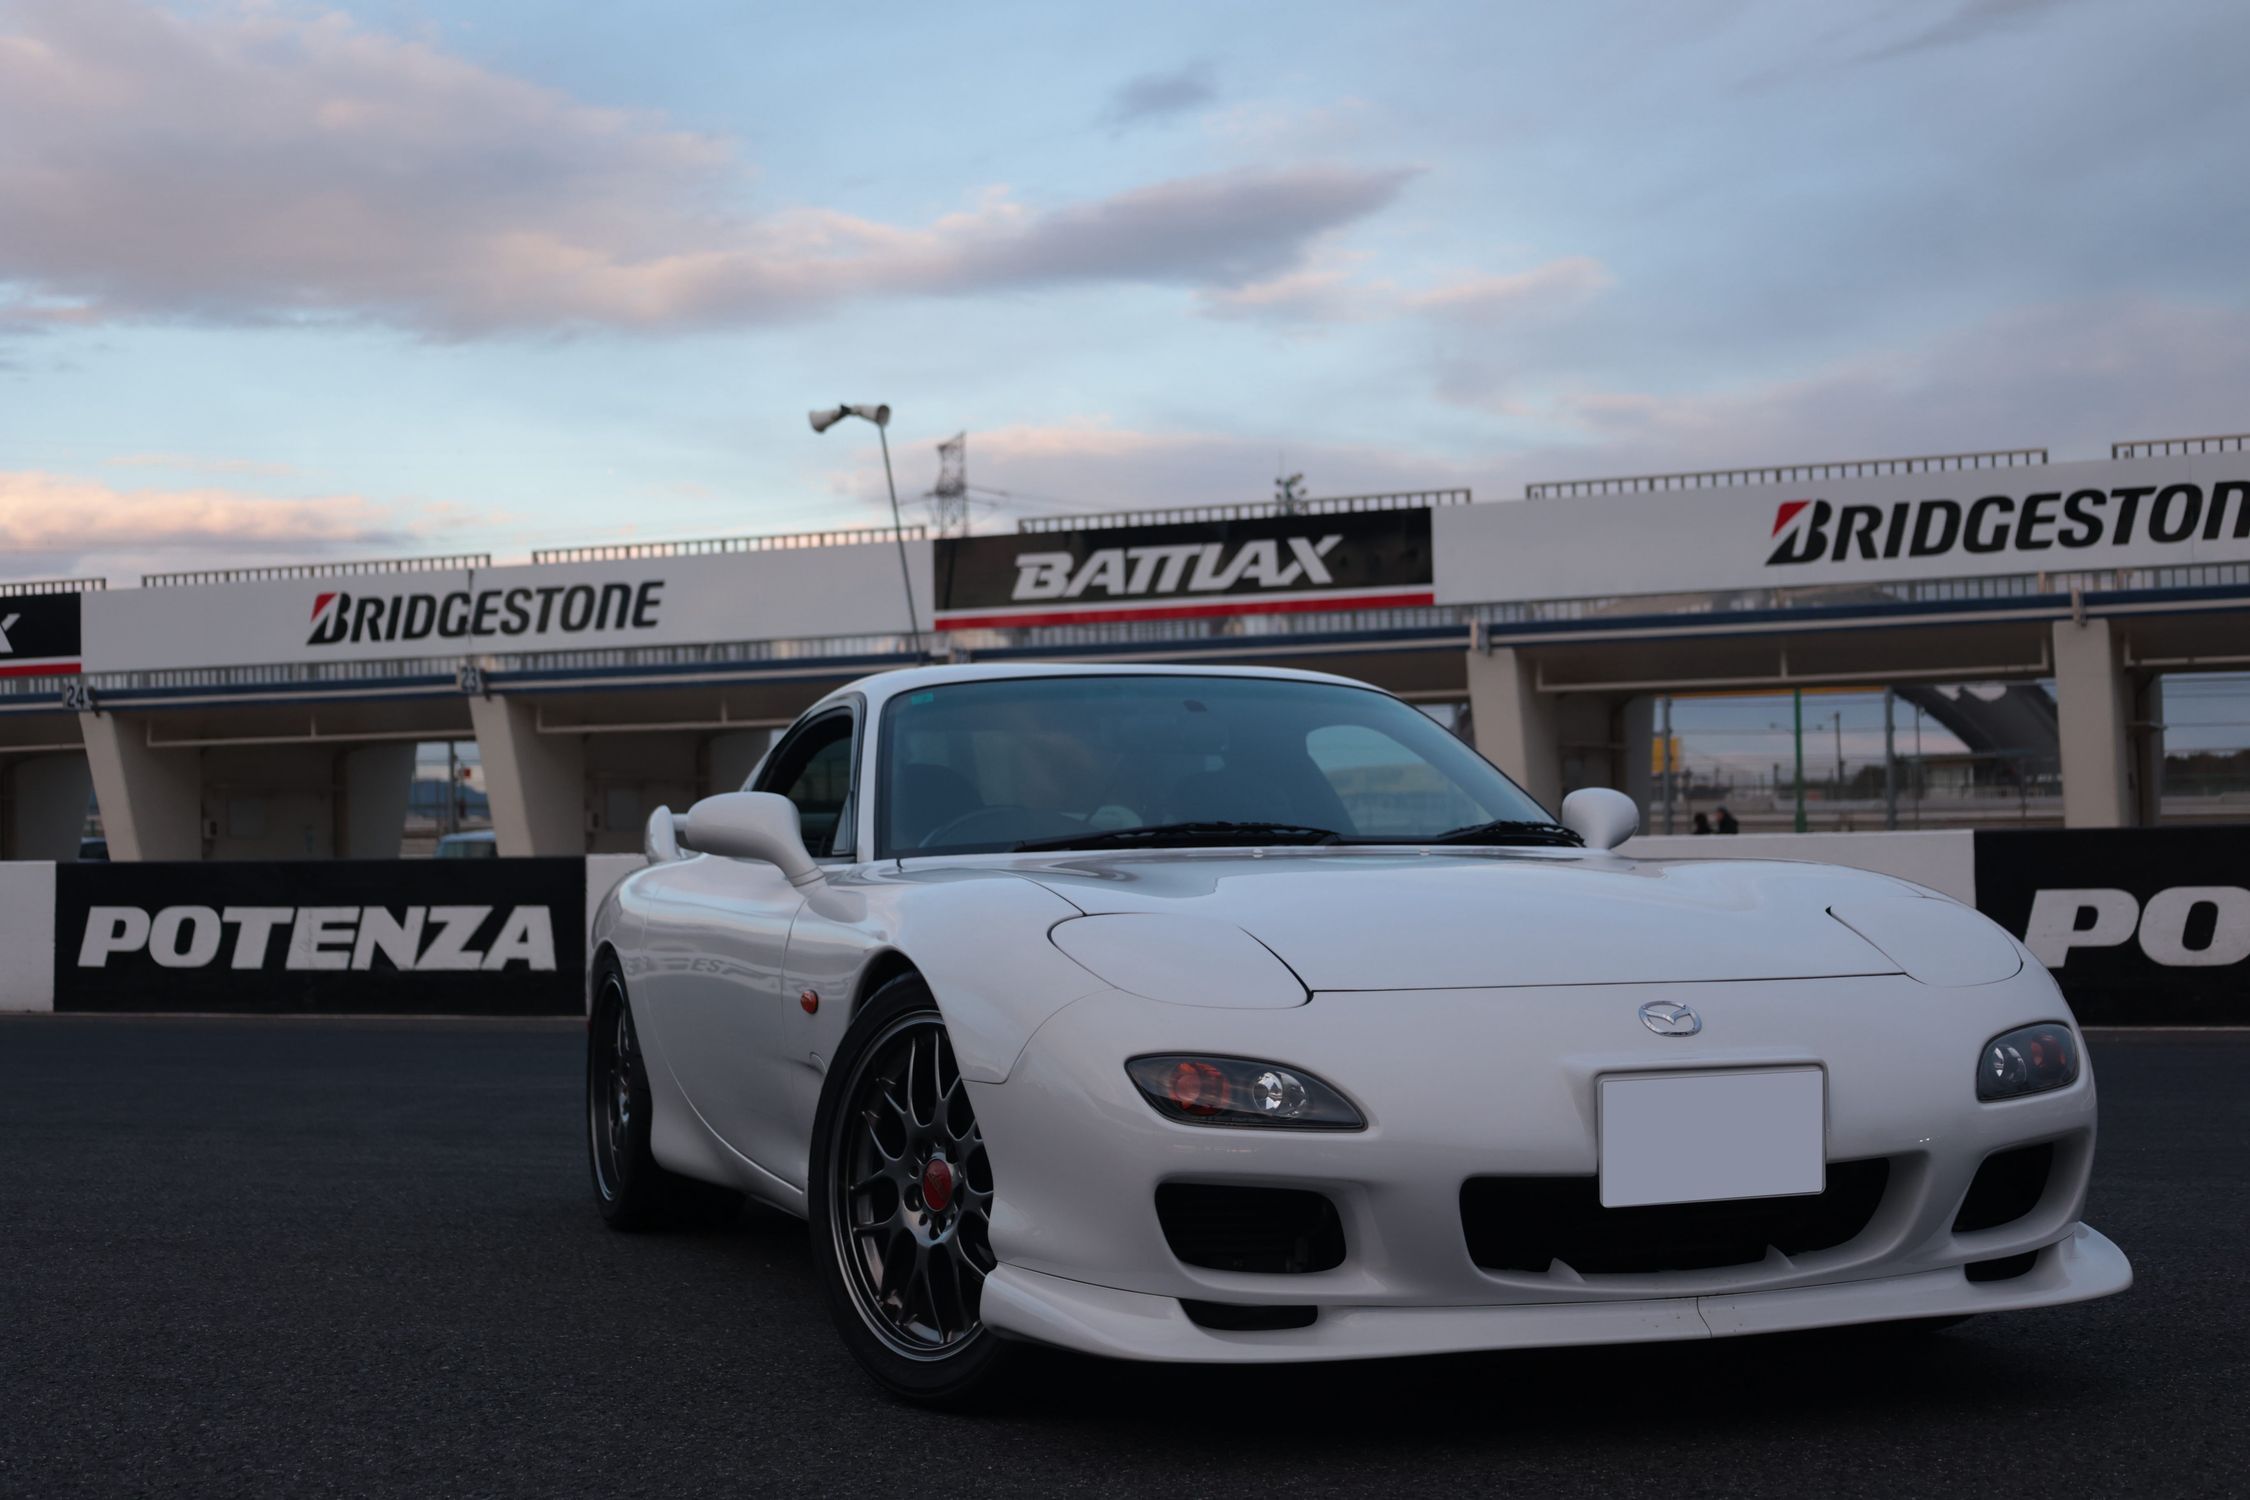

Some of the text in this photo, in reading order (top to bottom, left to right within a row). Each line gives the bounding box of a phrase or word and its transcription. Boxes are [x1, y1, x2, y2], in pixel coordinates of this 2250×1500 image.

[1012, 534, 1343, 600] BATTLAX
[306, 580, 665, 645] BRIDGESTONE
[67, 685, 85, 708] 24
[78, 905, 557, 971] POTENZA
[2024, 886, 2250, 968] PO
